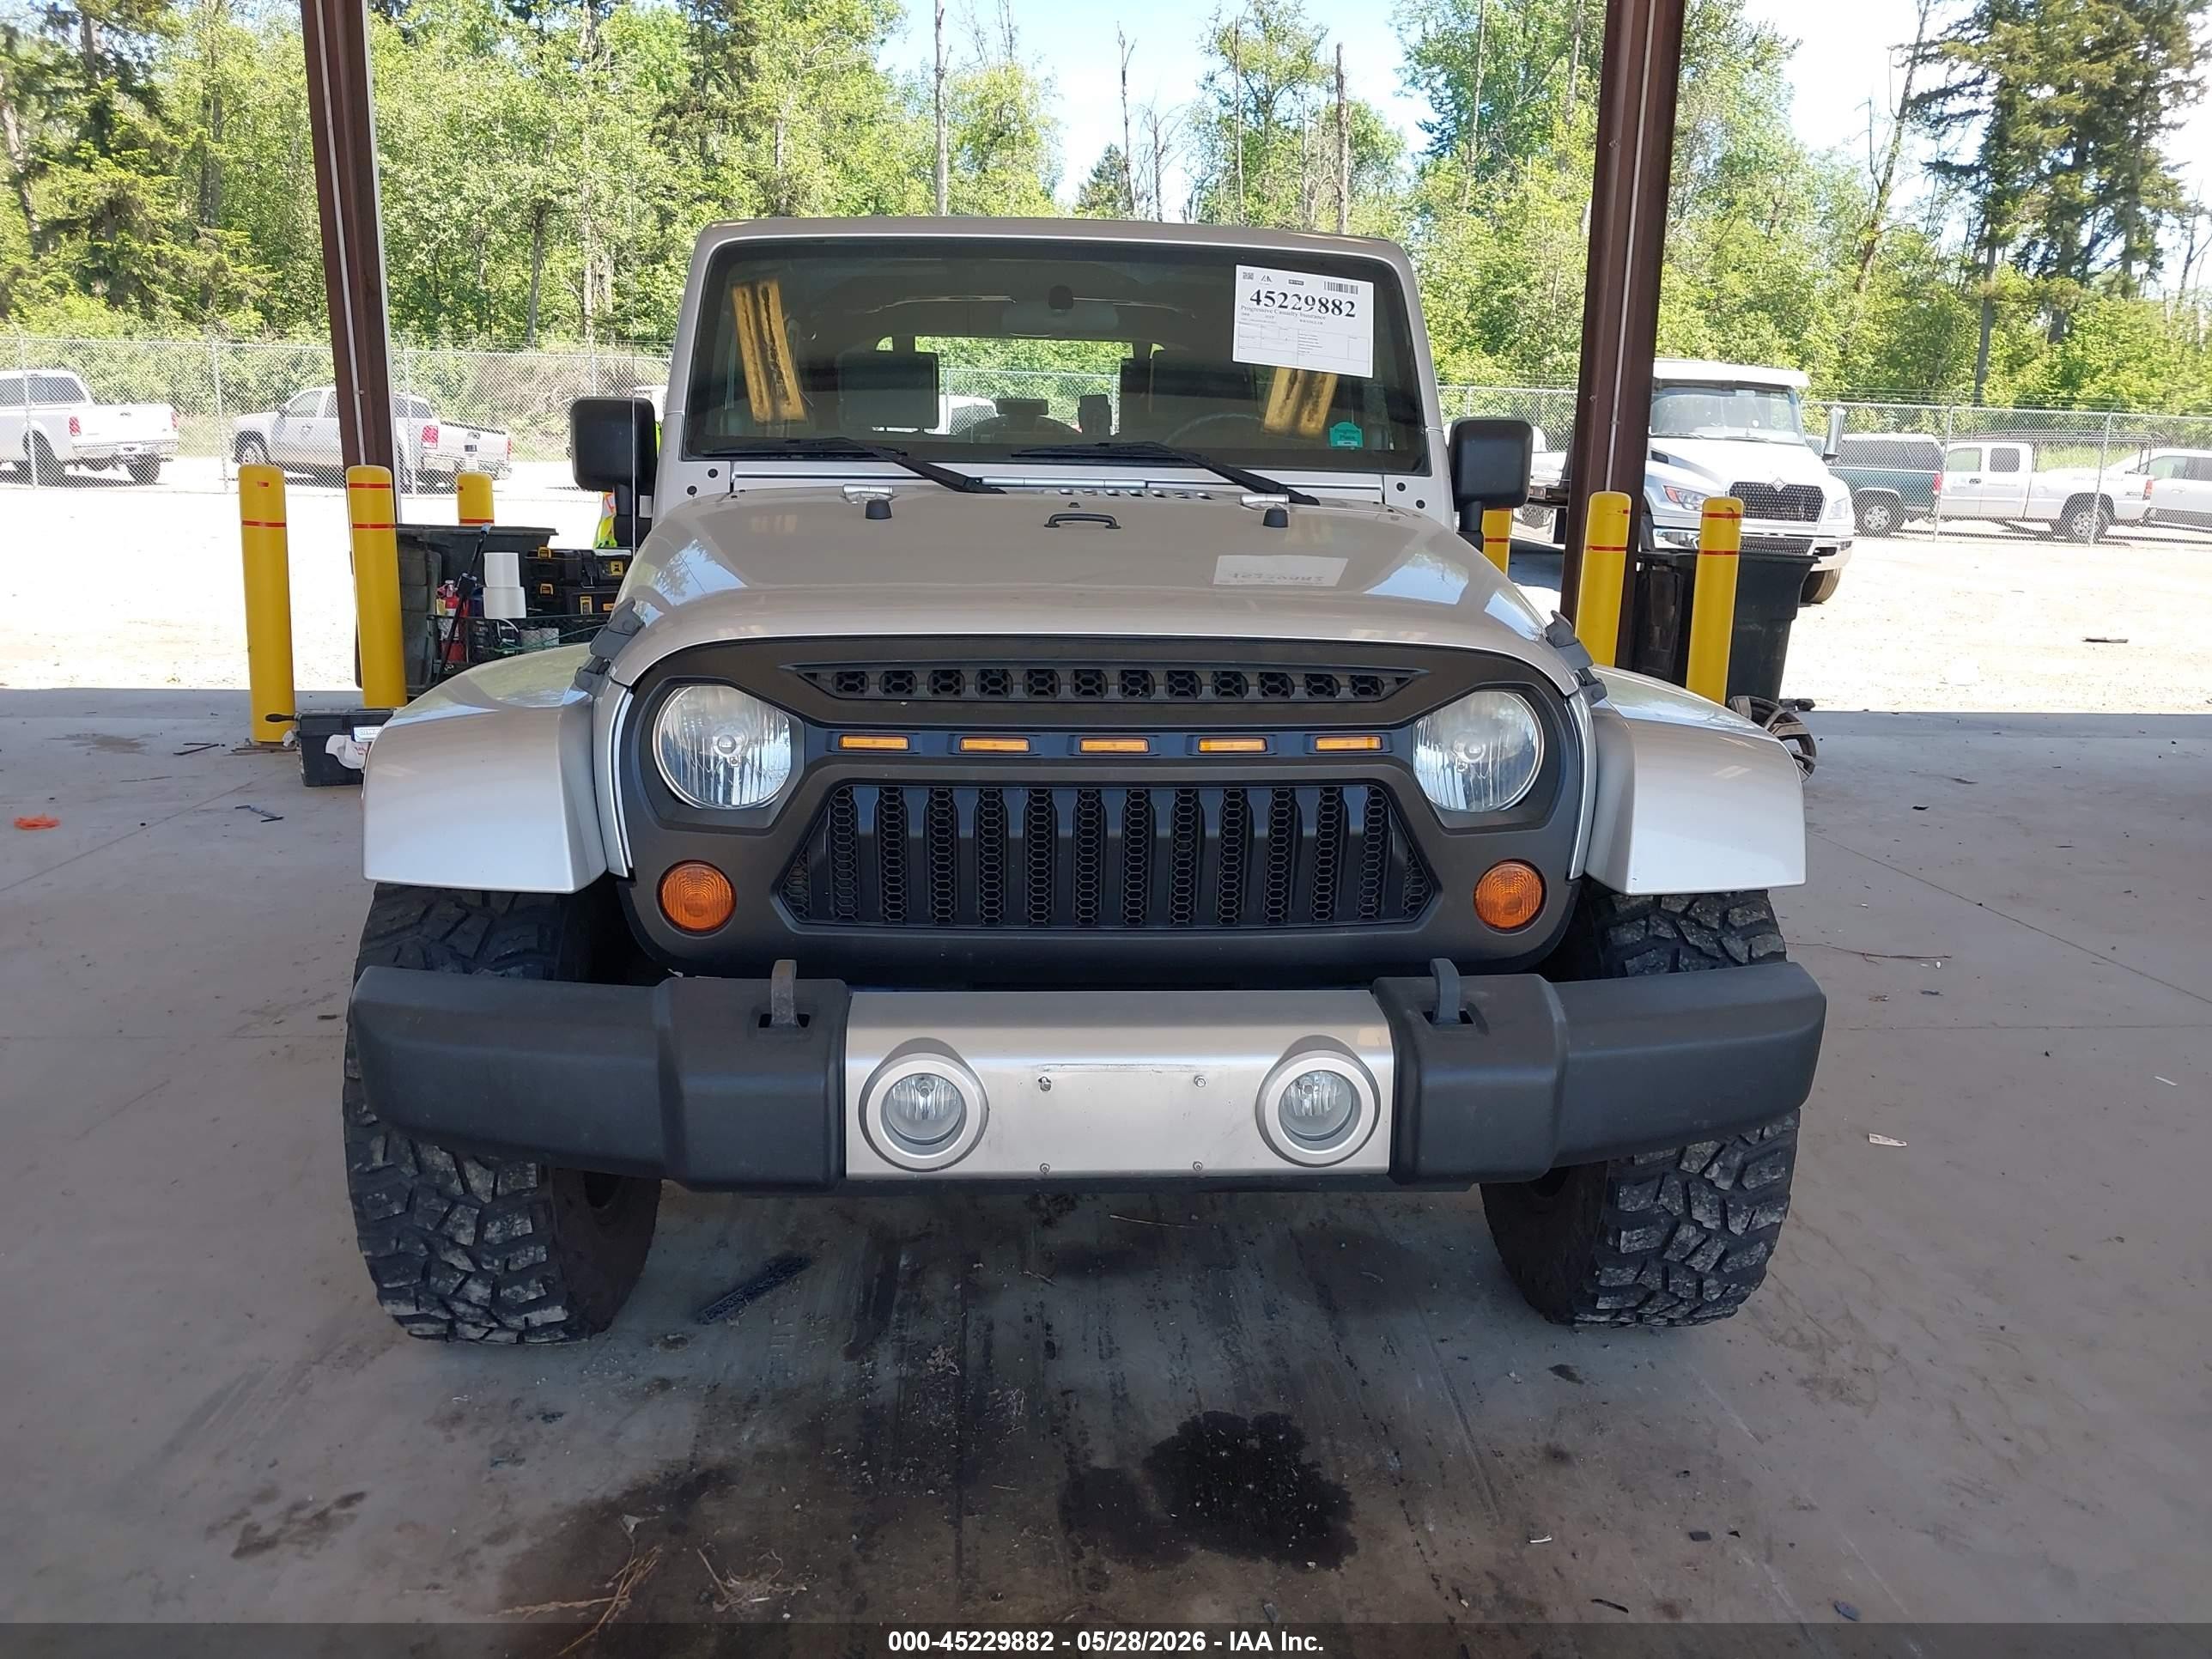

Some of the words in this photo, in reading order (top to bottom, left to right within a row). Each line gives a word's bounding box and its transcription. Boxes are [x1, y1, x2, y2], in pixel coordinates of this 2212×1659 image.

[1241, 305, 1273, 314] Progressive
[1274, 308, 1298, 317] Casualty
[1249, 289, 1356, 318] 45229882
